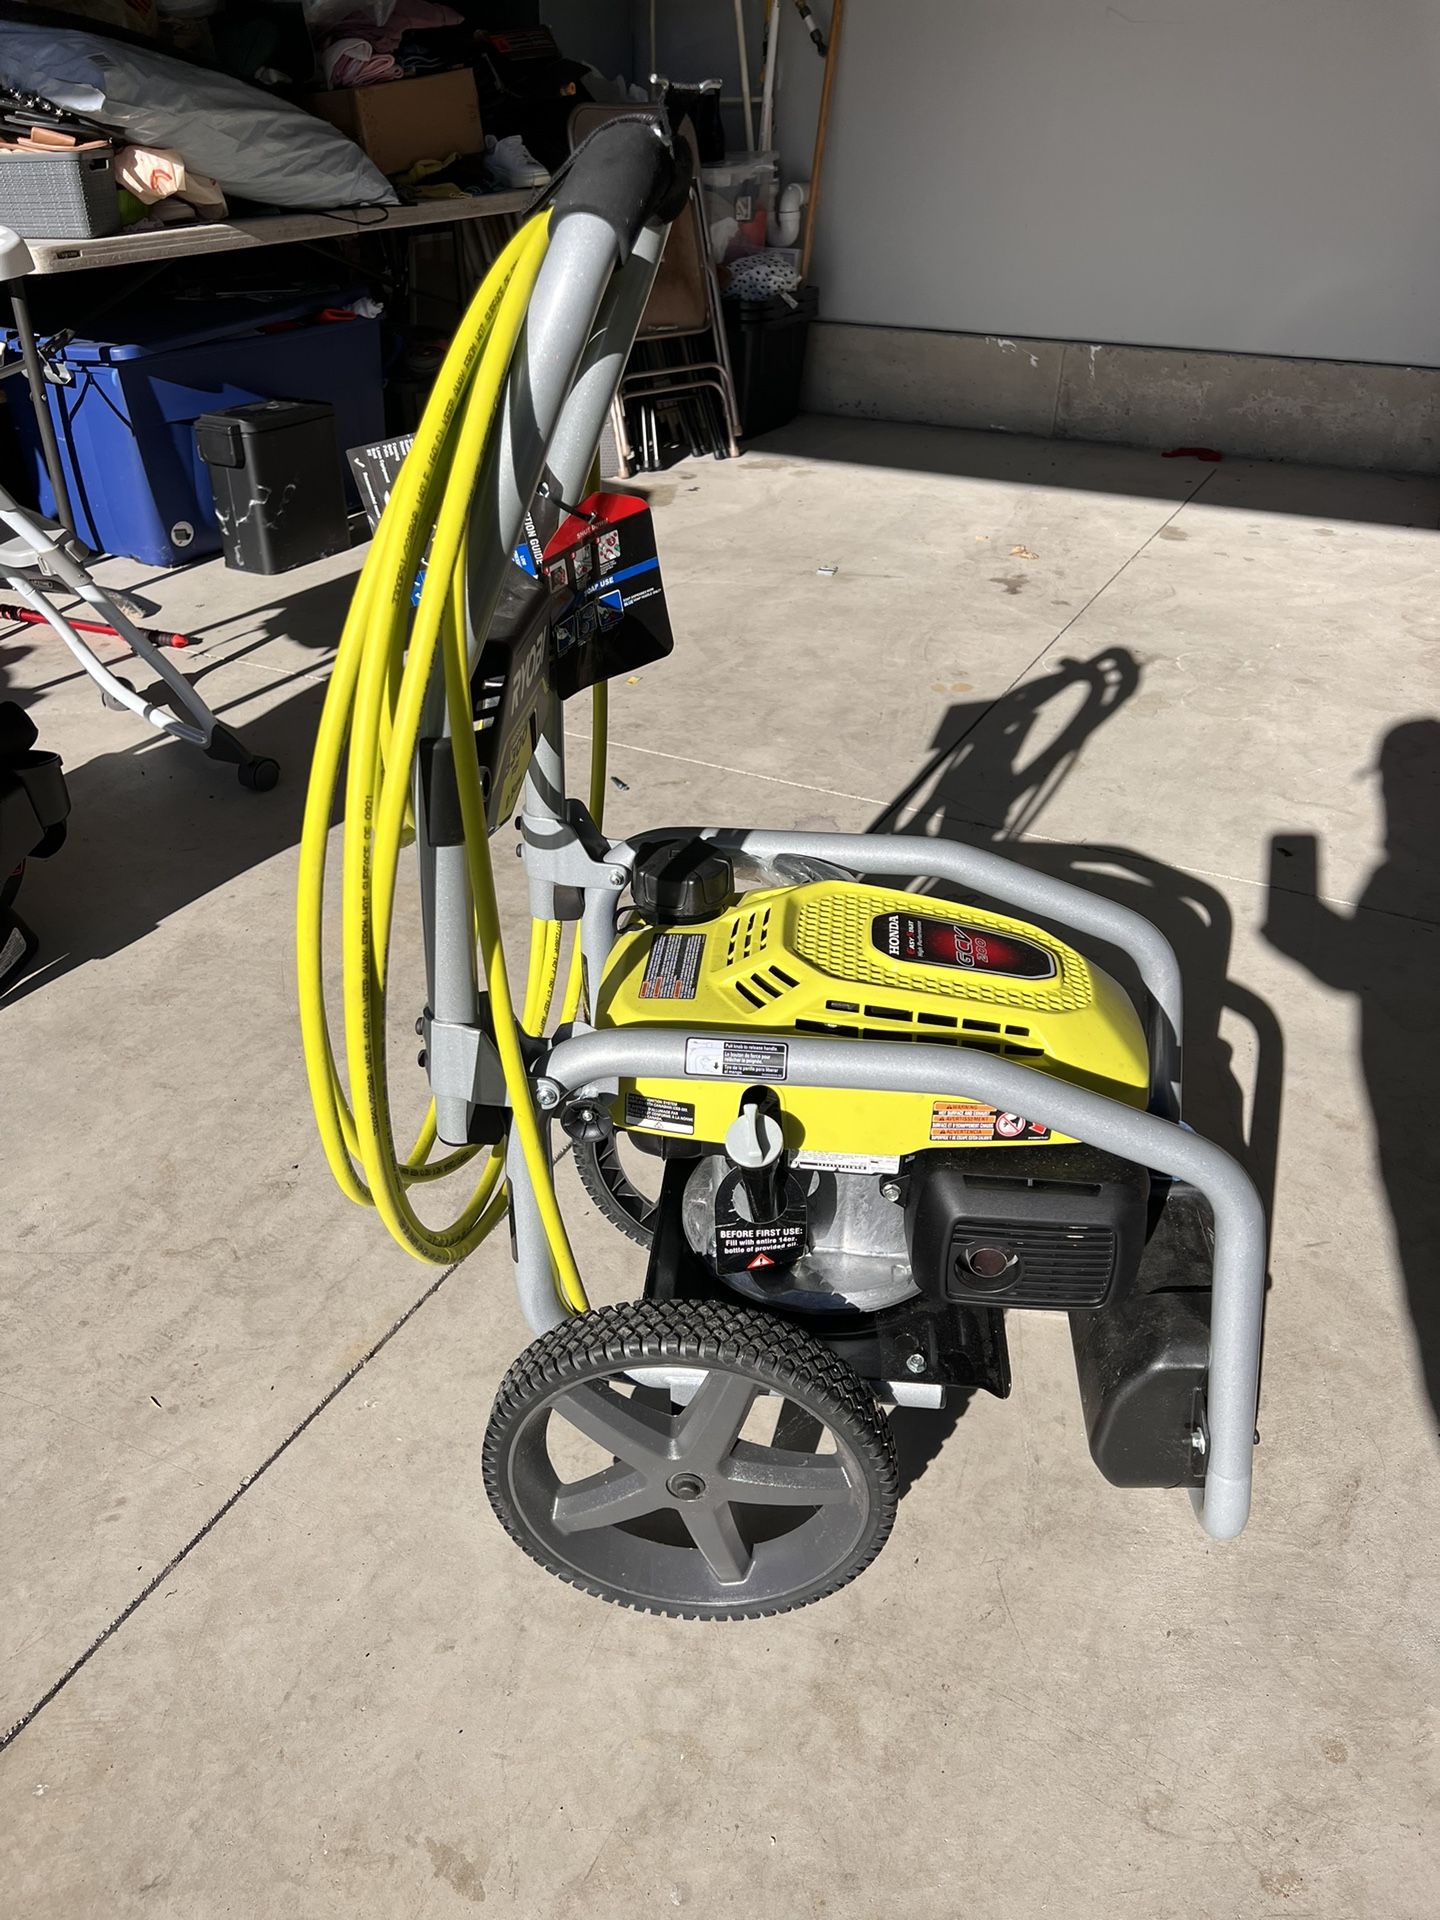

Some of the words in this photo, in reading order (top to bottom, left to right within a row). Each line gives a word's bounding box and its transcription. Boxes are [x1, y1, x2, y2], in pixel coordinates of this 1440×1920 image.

[530, 538, 543, 565] GUIDE
[599, 576, 614, 589] USE
[511, 625, 548, 716] RYOBI
[889, 915, 900, 956] HONDA
[905, 937, 916, 956] EASY
[953, 926, 975, 967] GCV
[975, 937, 989, 963] 200
[720, 1230, 754, 1239] BEFORE
[756, 1228, 781, 1238] FIRST
[783, 1227, 803, 1236] USE:
[724, 1246, 745, 1254] bottle
[746, 1245, 754, 1253] of
[755, 1242, 785, 1253] provided
